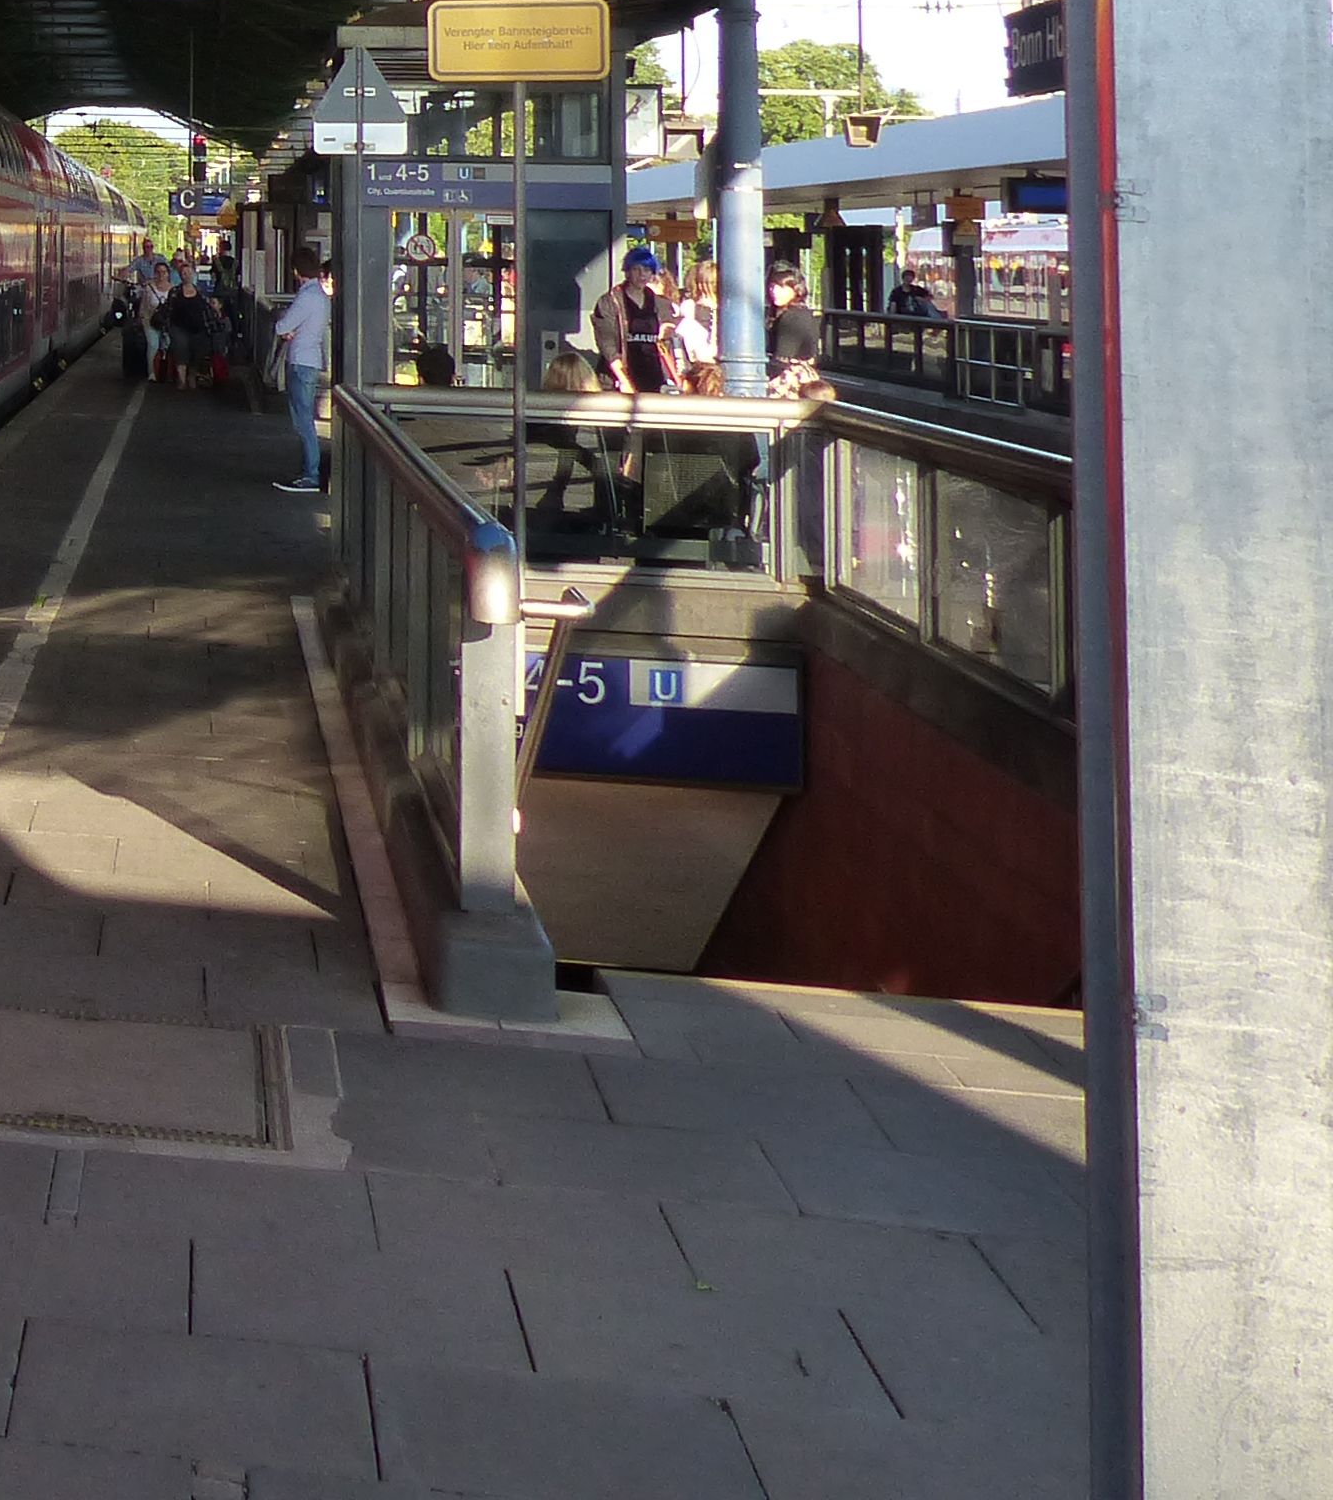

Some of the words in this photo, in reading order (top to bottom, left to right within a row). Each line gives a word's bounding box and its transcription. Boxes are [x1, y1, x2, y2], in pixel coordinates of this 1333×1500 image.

[444, 27, 495, 38] Verengter
[499, 25, 593, 38] Bahnsteigbereich
[463, 40, 484, 51] Hier
[1013, 28, 1042, 68] Bonn
[367, 164, 376, 181] 1
[395, 164, 430, 181] 4-5
[180, 189, 195, 209] C
[655, 672, 677, 700] U
